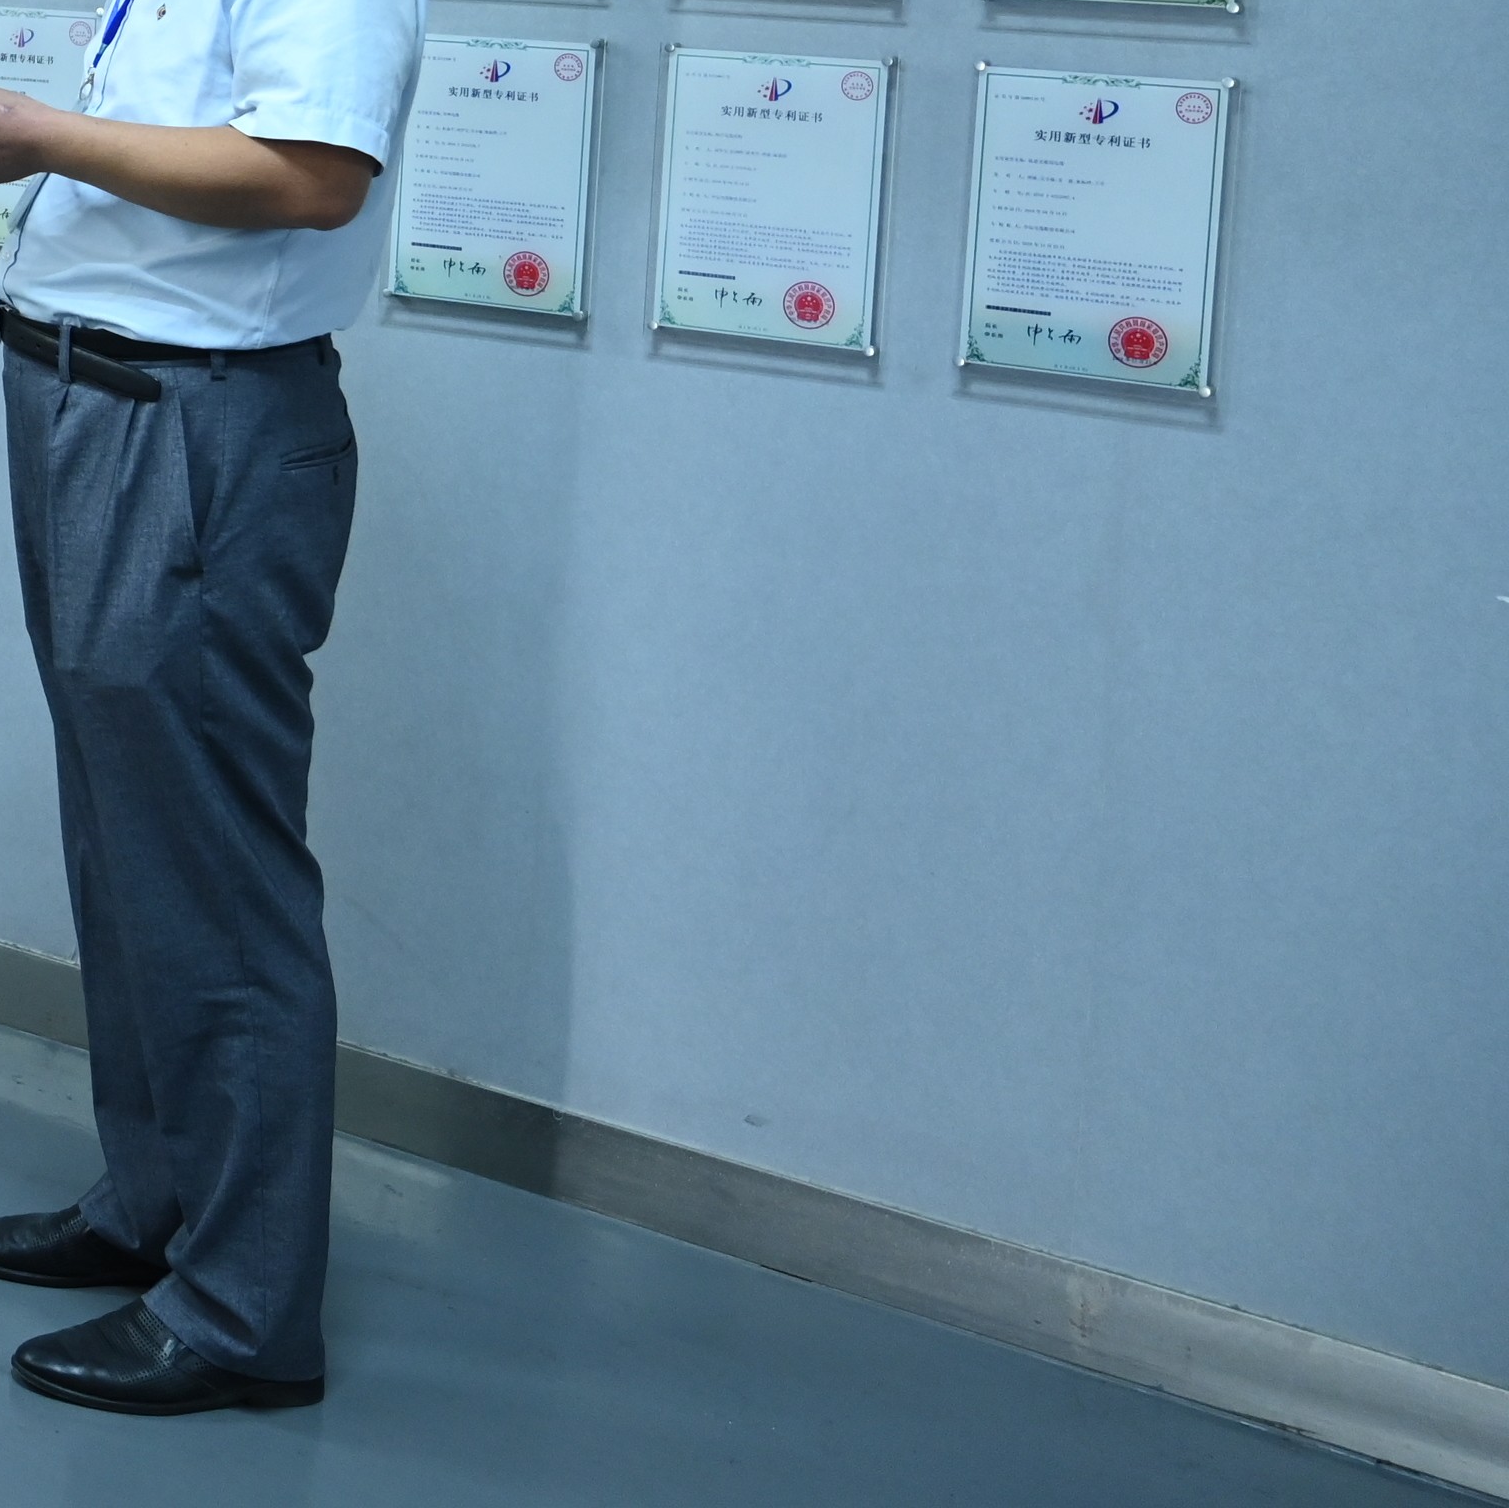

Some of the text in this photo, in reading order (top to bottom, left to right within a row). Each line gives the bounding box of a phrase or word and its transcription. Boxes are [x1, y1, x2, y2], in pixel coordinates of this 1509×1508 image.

[448, 85, 540, 103] 实用新型专利证书
[721, 105, 824, 124] 实用新型专利证书
[1035, 129, 1152, 150] 实用新型专利证书
